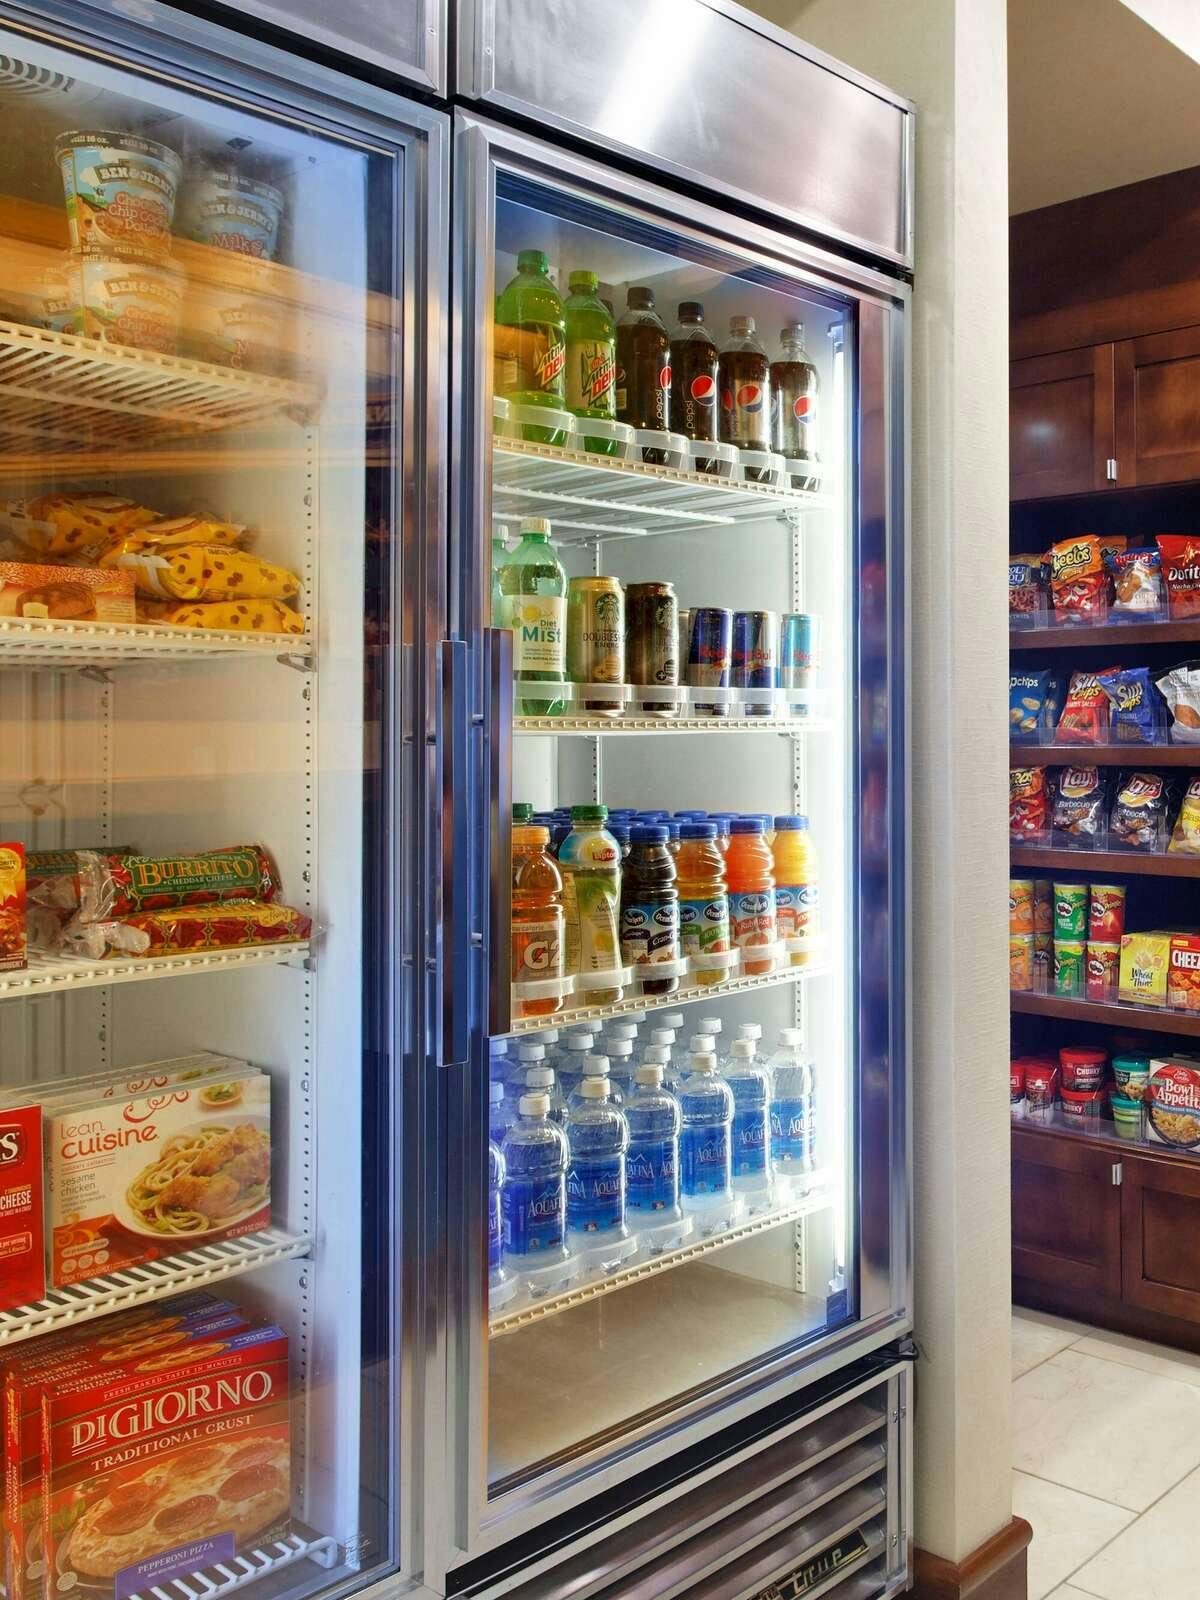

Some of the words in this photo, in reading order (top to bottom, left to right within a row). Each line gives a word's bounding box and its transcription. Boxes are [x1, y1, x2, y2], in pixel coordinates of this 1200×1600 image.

[100, 167, 128, 180] BEN
[685, 401, 695, 429] pepsi
[583, 632, 621, 642] DOUBLES
[1009, 677, 1038, 688] pchips
[138, 860, 254, 887] BURRITO
[1132, 968, 1153, 981] Wheat
[1165, 1079, 1194, 1094] Bowl
[61, 1118, 105, 1139] lean
[61, 1124, 158, 1160] cuisine
[61, 1173, 96, 1187] sesame
[61, 1181, 96, 1197] chicken
[0, 1190, 32, 1210] CHEESE
[72, 1370, 272, 1452] DIGIORNO
[91, 1427, 203, 1472] TRADITIONAL
[205, 1414, 254, 1435] CRUST
[137, 1550, 188, 1573] PEPPERONI
[189, 1542, 214, 1556] PIZZA
